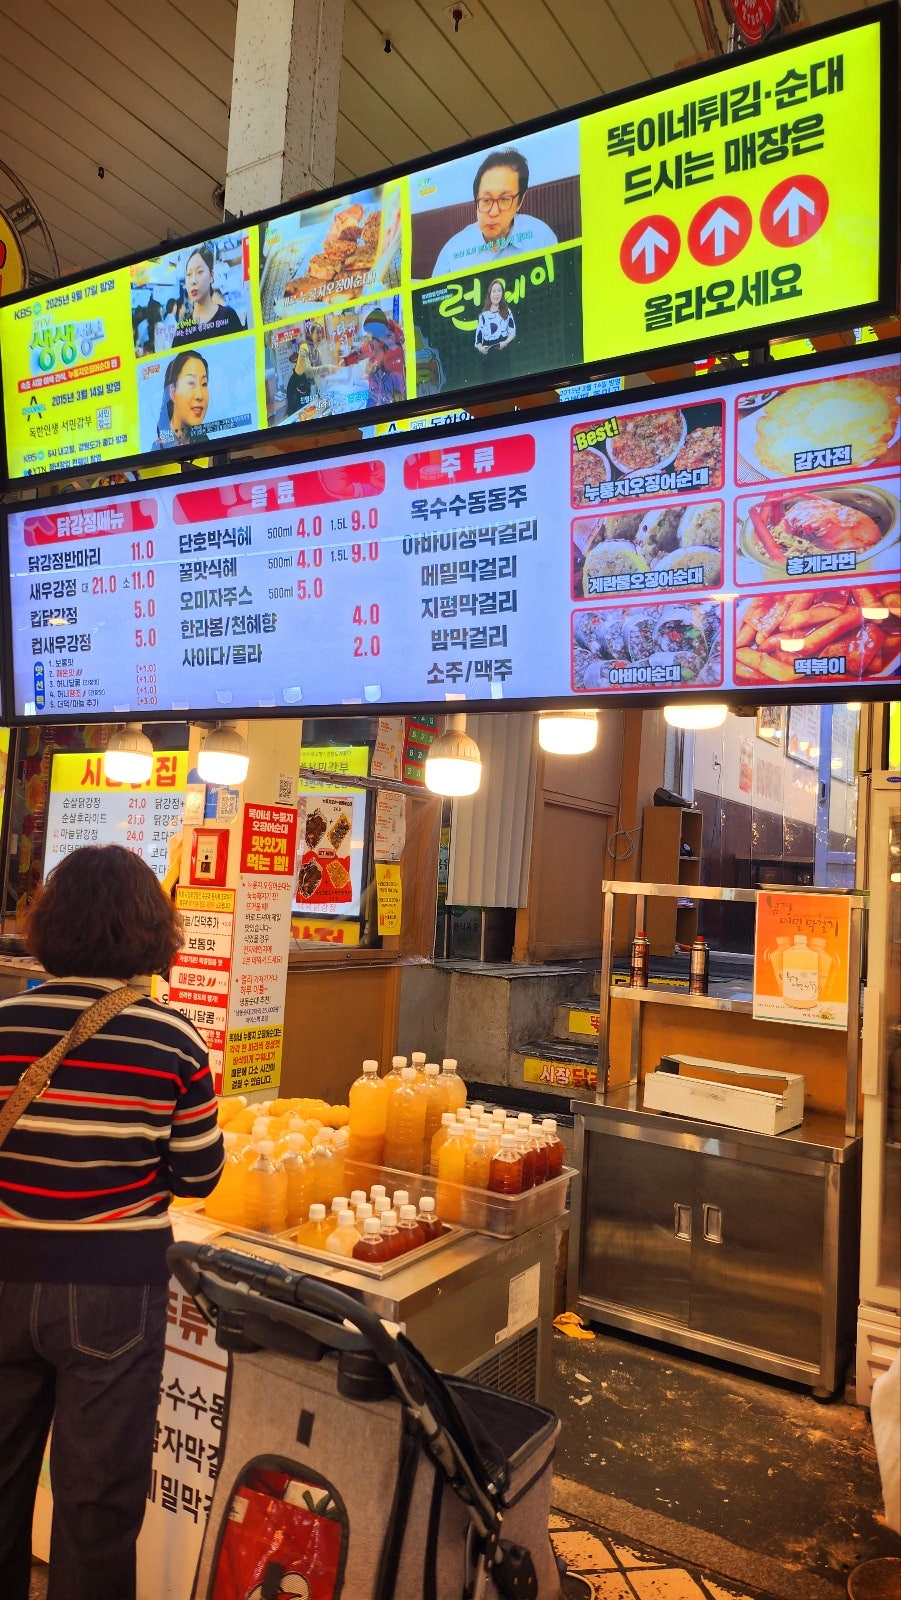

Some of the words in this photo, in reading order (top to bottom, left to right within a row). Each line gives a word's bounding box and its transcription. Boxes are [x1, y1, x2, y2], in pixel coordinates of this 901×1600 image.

[607, 54, 844, 157] 똑이네튀김·순대
[624, 151, 714, 205] 드시는
[725, 113, 824, 175] 매장은
[14, 307, 32, 320] KBS
[46, 295, 69, 310] 2025년
[72, 290, 82, 302] 9월
[85, 285, 97, 297] 17일
[100, 280, 114, 293] 방영
[644, 263, 802, 332] 올라오세요
[52, 392, 74, 406] 2015년
[76, 389, 87, 401] 3월
[90, 385, 104, 397] 14일
[106, 381, 120, 393] 방영
[29, 422, 58, 438] 독한인생
[62, 416, 92, 431] 서민갑부
[574, 416, 620, 452] Best!
[23, 453, 37, 463] KBS
[33, 465, 46, 474] YTN
[794, 445, 852, 472] 감자전
[584, 466, 709, 502] 누룽지오징어순대
[411, 484, 527, 522] 옥수수동동주
[57, 509, 124, 538] 닭강정메뉴
[178, 526, 252, 554] 단호박식혜
[267, 525, 293, 540] 500ml
[296, 515, 323, 539] 4.0
[330, 517, 348, 531] 1.5L
[351, 507, 379, 532] 9.0
[402, 519, 538, 556] 아바이생막걸리
[28, 547, 101, 573] 닭강정반마리
[131, 539, 154, 561] 11.0
[179, 557, 238, 583] 꿀맛식혜
[268, 556, 293, 570] 500ml
[296, 547, 323, 569] 4.0
[330, 549, 348, 562] 1.5L
[351, 541, 379, 564] 9.0
[786, 551, 857, 576] 홍게라면
[421, 554, 517, 587] 메밀막걸리
[29, 578, 77, 600] 새우강정
[82, 583, 89, 593] 대
[92, 574, 117, 595] 21.0
[123, 577, 131, 589] 소
[131, 569, 155, 590] 11.0
[180, 585, 253, 611] 오미자주스
[268, 586, 294, 600] 500ml
[297, 577, 323, 600] 5.0
[30, 606, 78, 628] 컵닭강정
[134, 599, 156, 619] 5.0
[421, 590, 518, 619] 지평막걸리
[180, 612, 277, 640] 한라봉/천혜향
[352, 603, 380, 626] 4.0
[31, 633, 92, 655] 컵새우강정
[135, 628, 157, 648] 5.0
[431, 624, 508, 651] 밤막걸리
[55, 659, 74, 667] 보통맛
[182, 644, 262, 668] 사이다/콜라
[353, 635, 381, 658] 2.0
[56, 669, 75, 678] 매운맛
[136, 664, 156, 673] (+1.0)
[427, 658, 512, 684] 소주/맥주
[608, 665, 681, 684] 아바이순대
[794, 656, 846, 676] 떡볶이
[56, 678, 80, 688] 허니달콤
[136, 675, 157, 684] (+1.0)
[136, 685, 157, 694] (+1.0)
[57, 699, 85, 709] 더덕/마늘
[86, 698, 100, 708] 추가
[137, 696, 158, 705] (+3.0)
[63, 797, 101, 809] 순살닭강정
[129, 798, 147, 808] 21.0
[61, 813, 107, 824] 순살후라이드
[128, 815, 145, 825] 21.0
[252, 820, 289, 835] 오징어순대
[272, 811, 294, 824] 누룽지
[60, 829, 98, 840] 마늘닭강정
[126, 831, 144, 841] 24.0
[251, 835, 287, 855] 맛있게
[247, 853, 271, 871] 먹는
[274, 855, 290, 872] 법!
[189, 938, 216, 952] 보통맛
[179, 972, 206, 987] 매운맛
[244, 1079, 249, 1087] 수
